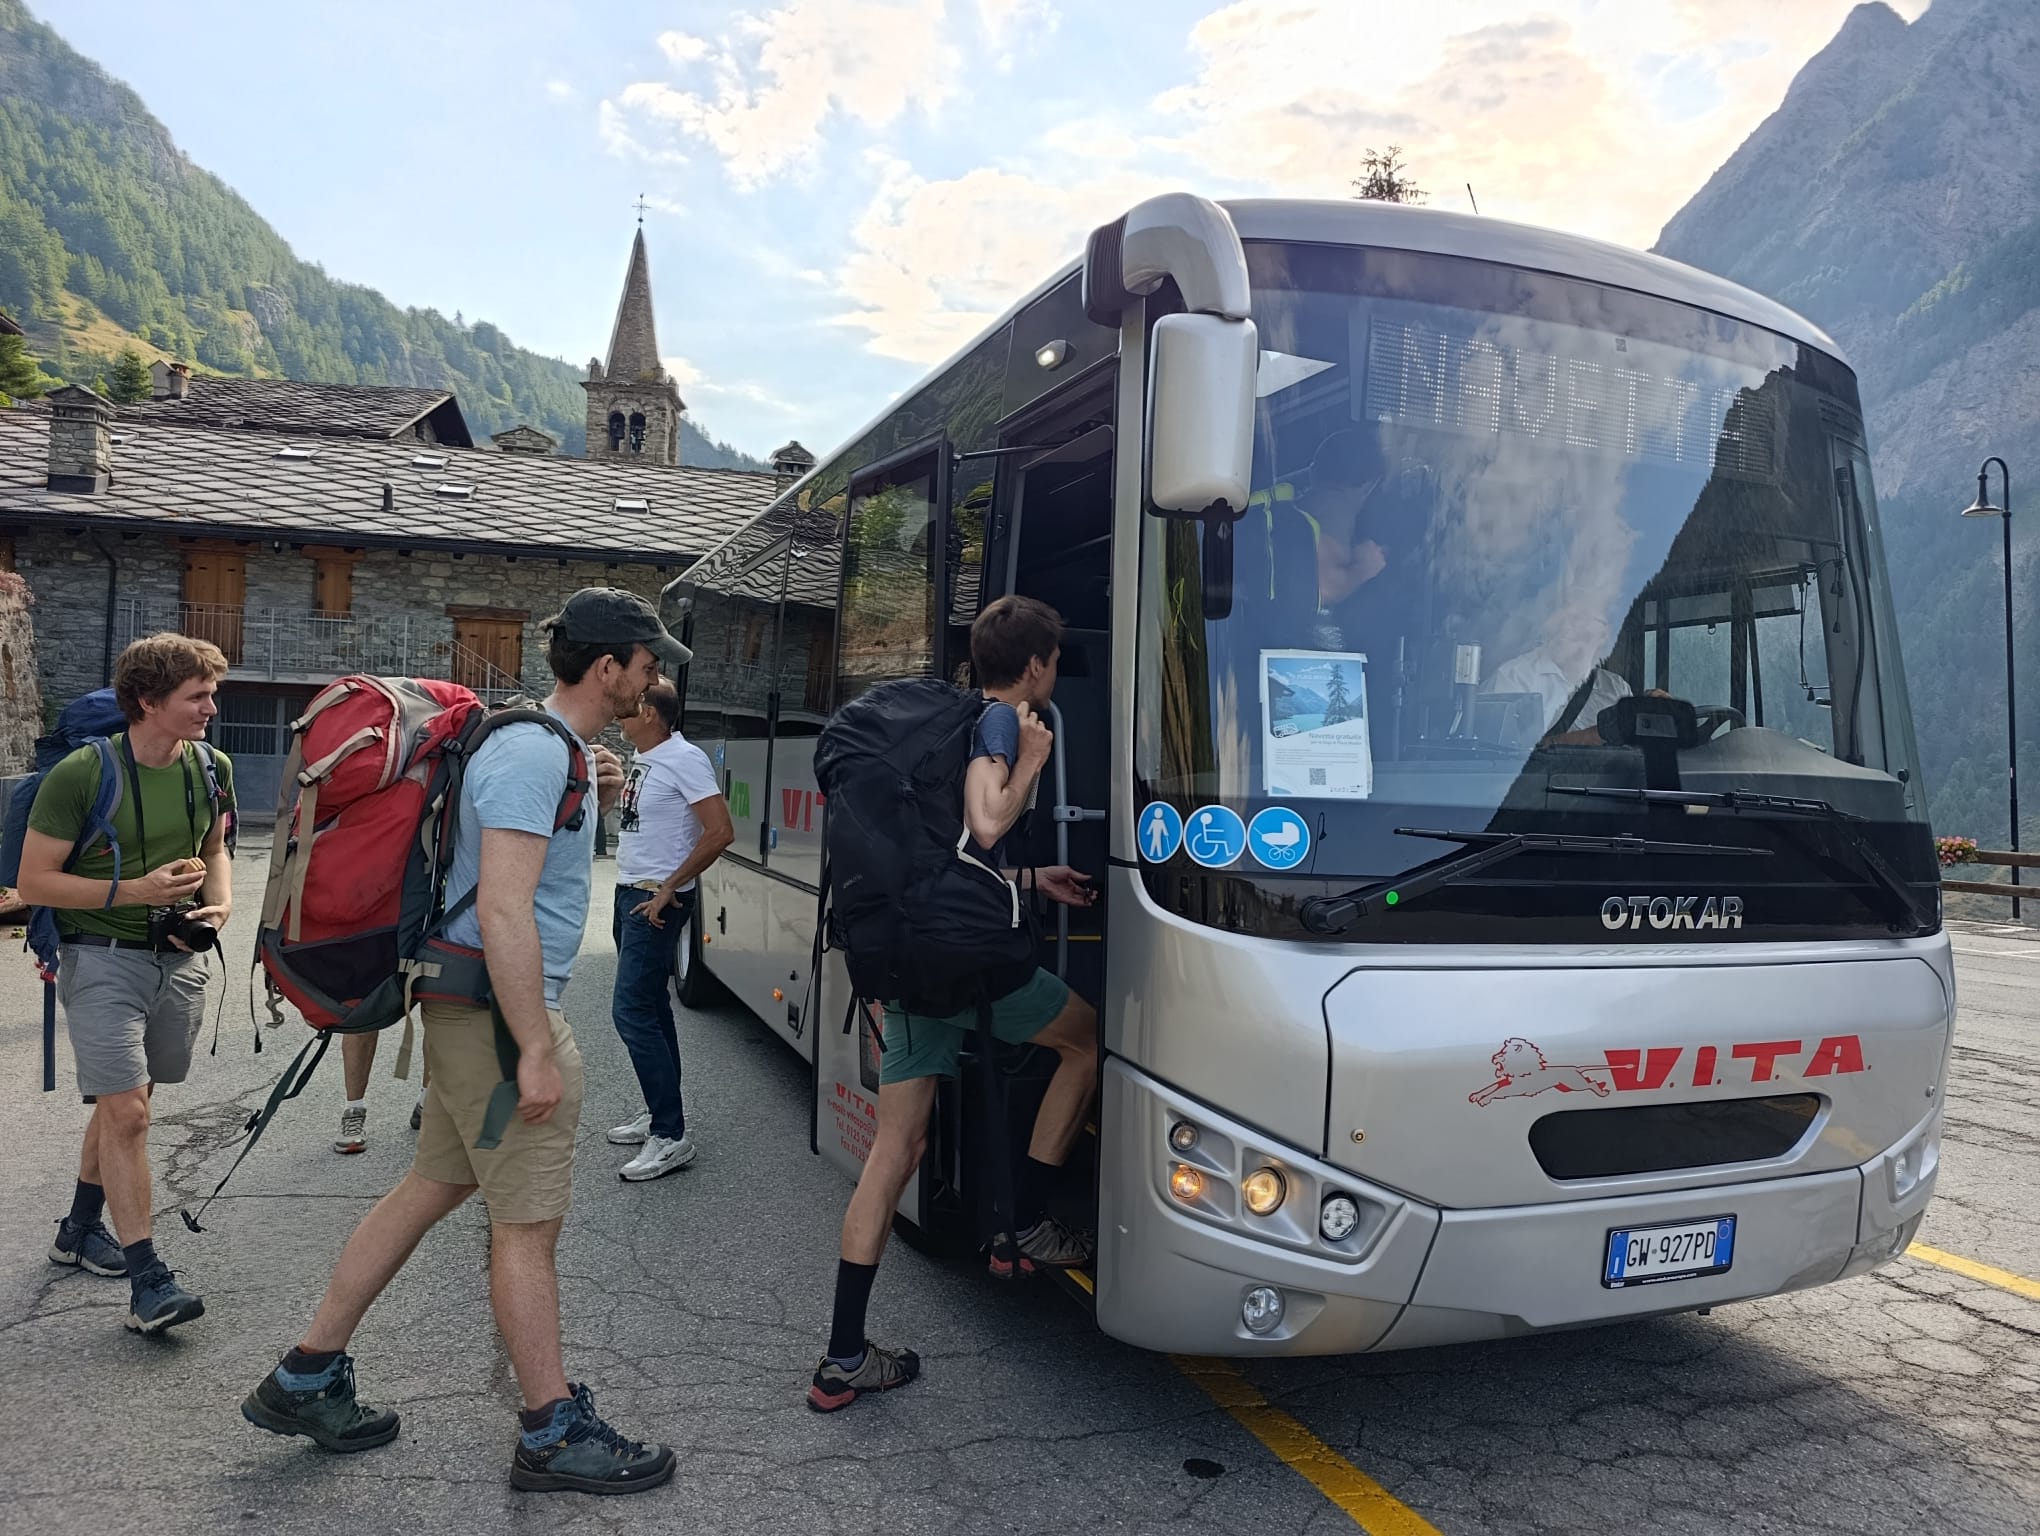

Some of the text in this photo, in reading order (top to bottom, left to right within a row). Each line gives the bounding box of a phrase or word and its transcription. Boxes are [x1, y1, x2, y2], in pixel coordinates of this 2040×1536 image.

[1601, 896, 1744, 930] OTOKAR
[1626, 1231, 1716, 1267] GW 927PD
